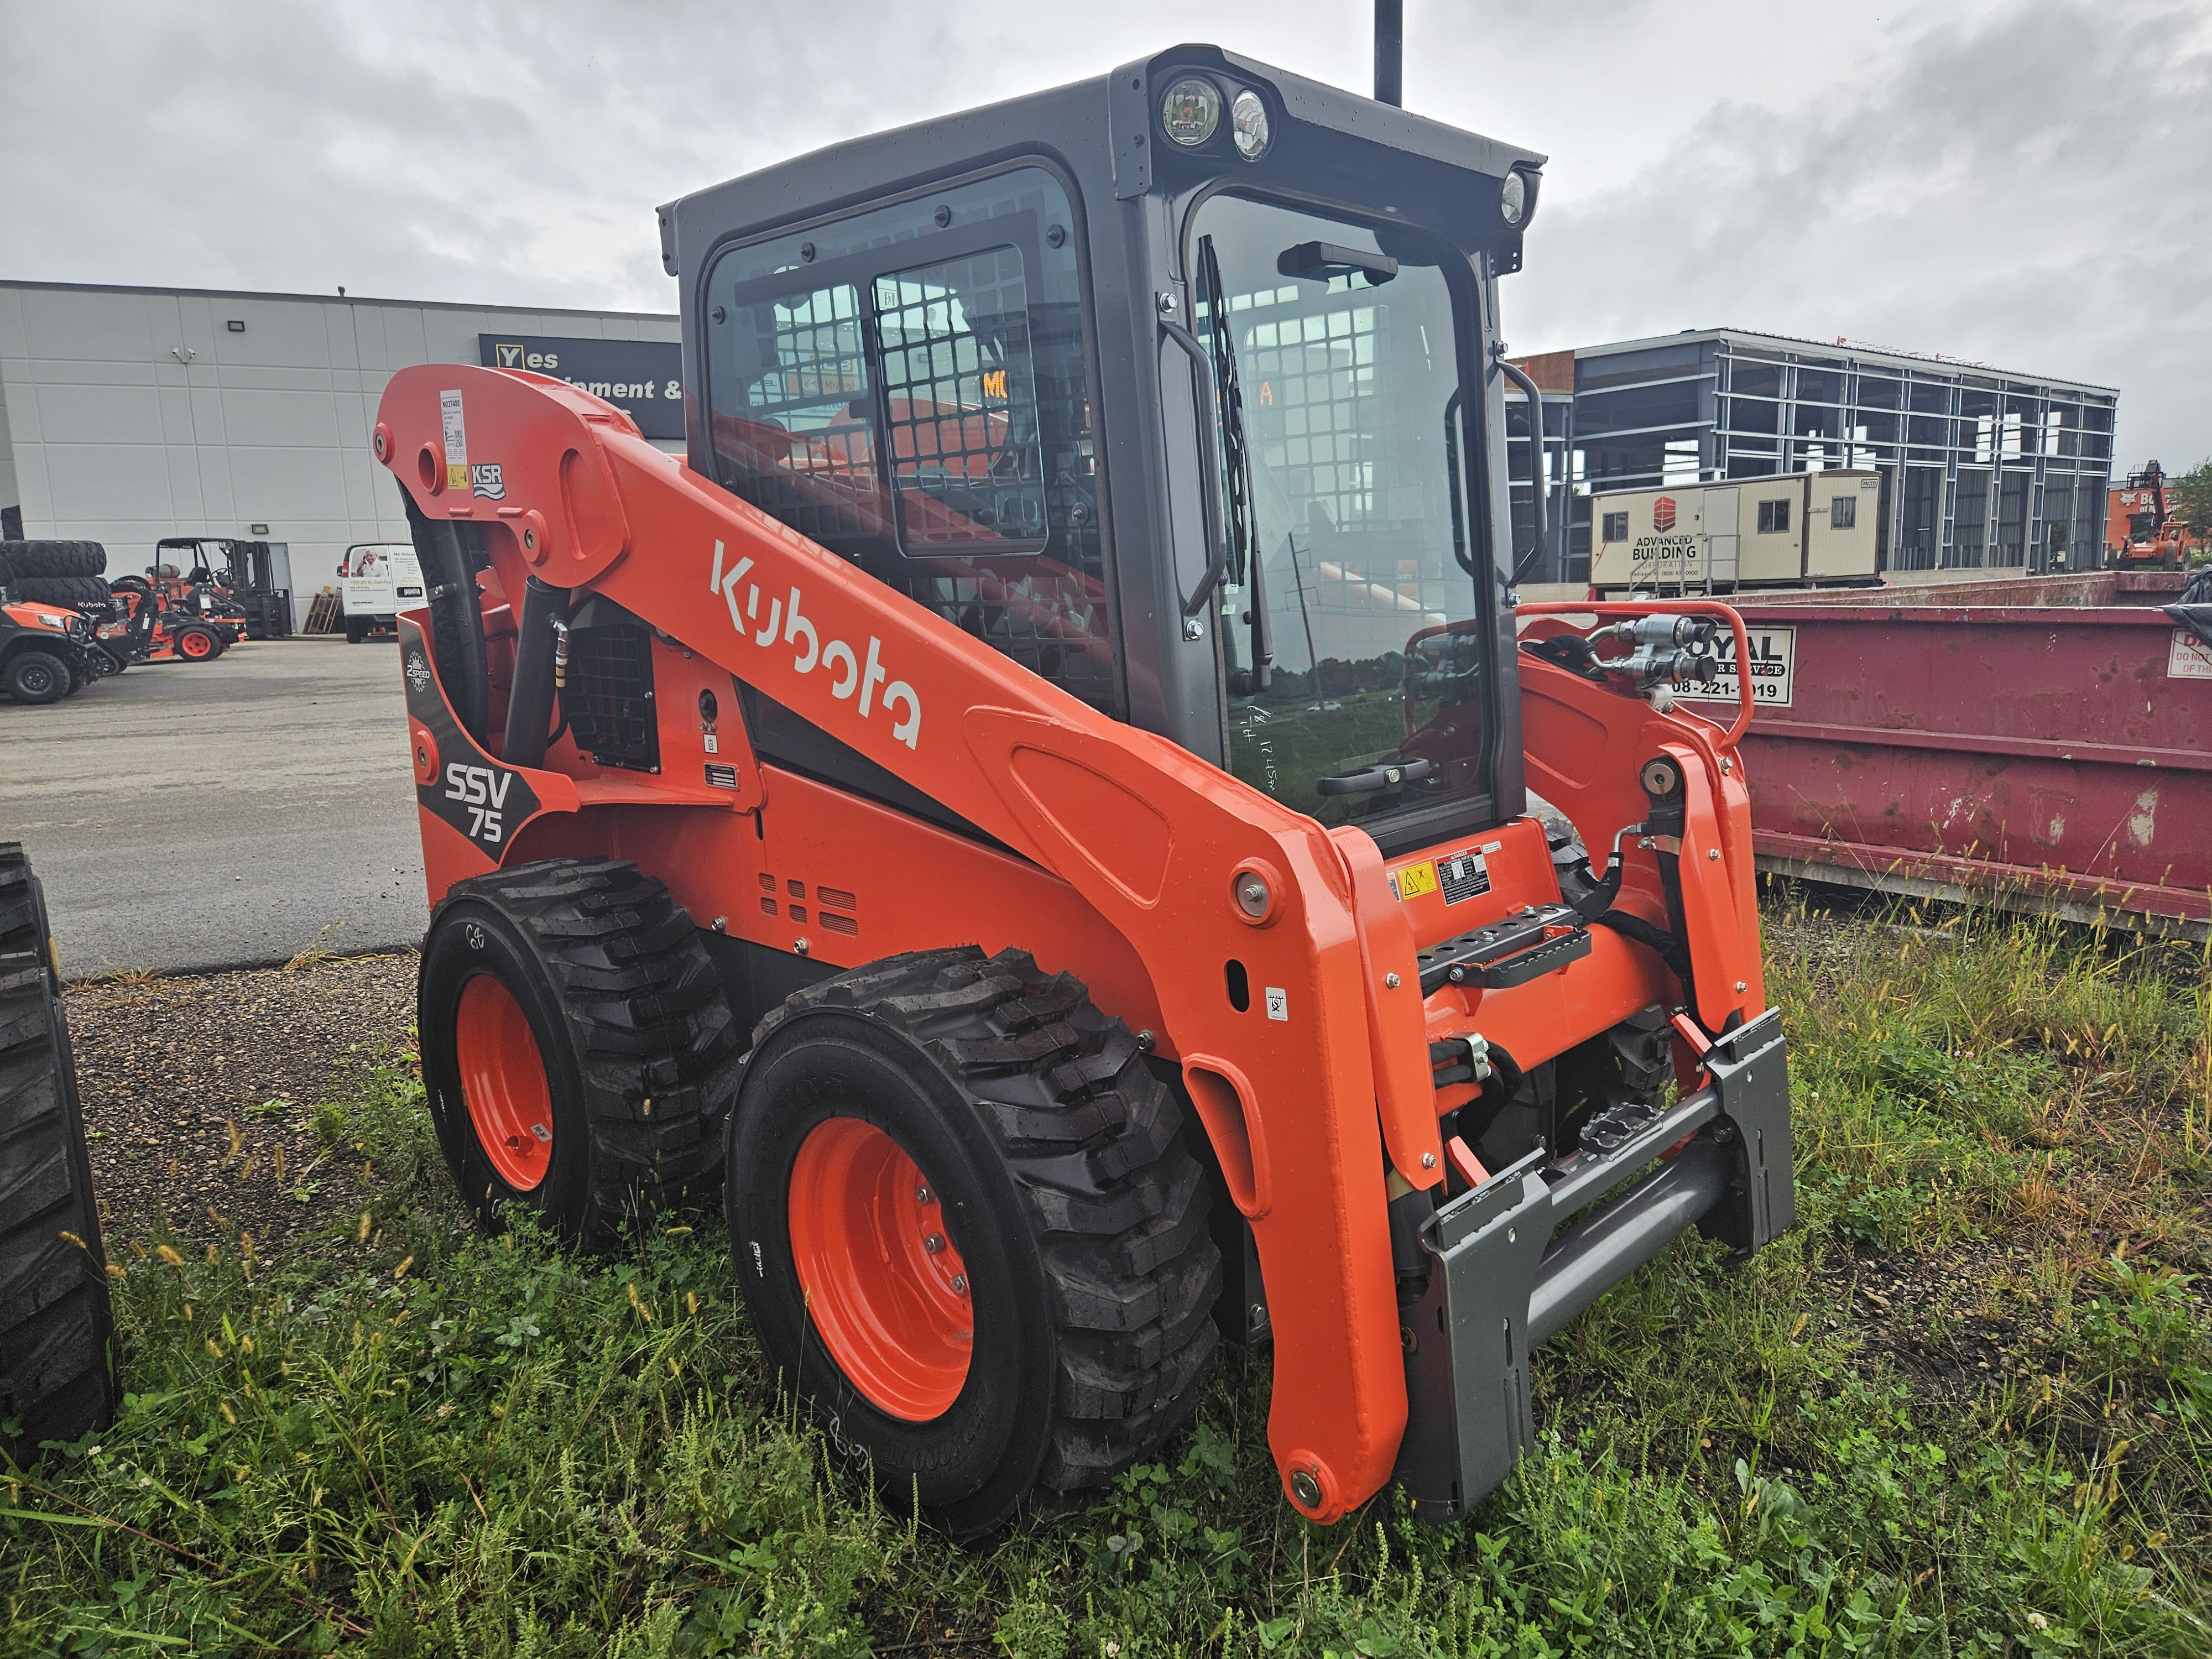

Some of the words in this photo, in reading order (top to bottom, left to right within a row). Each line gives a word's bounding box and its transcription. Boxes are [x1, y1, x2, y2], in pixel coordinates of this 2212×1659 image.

[499, 347, 559, 369] Yes
[664, 380, 682, 399] &
[472, 465, 502, 484] KSR
[710, 539, 921, 750] Kubota
[2176, 653, 2189, 661] DO
[2191, 653, 2210, 661] NOT
[2183, 664, 2195, 672] OF
[445, 763, 512, 809] SSV
[468, 806, 502, 843] 75
